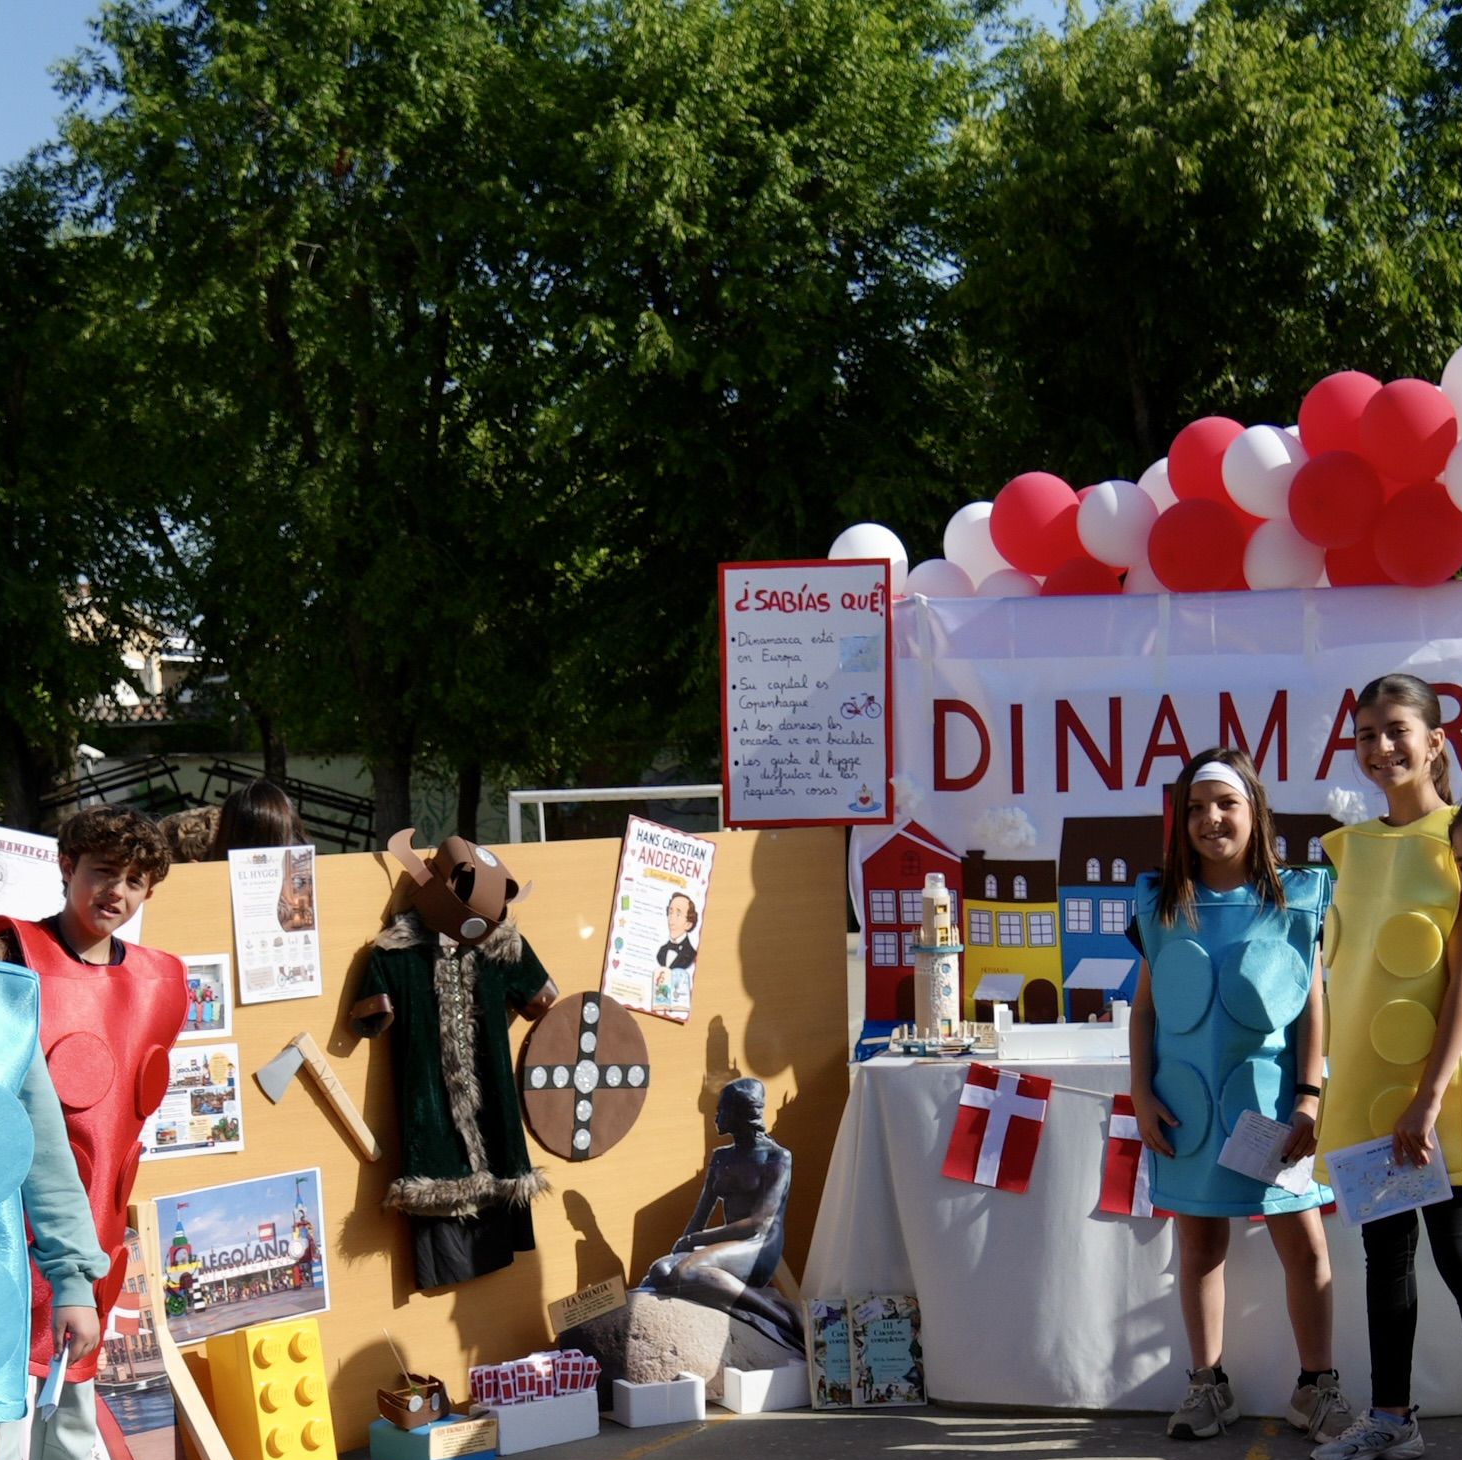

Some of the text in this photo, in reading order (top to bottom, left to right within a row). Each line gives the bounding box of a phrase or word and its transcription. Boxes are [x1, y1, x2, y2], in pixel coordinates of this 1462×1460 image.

[735, 581, 830, 613] ¿SABÍAS
[738, 628, 835, 647] Dinamarca está
[737, 649, 802, 668] en Europa
[739, 674, 829, 694] Su capital es
[740, 715, 843, 731] A los daneses les
[740, 730, 874, 746] encanta ir en bicicleta
[742, 750, 862, 773] Les gusta el hygge
[743, 767, 858, 788] y disfrutar de las
[743, 786, 796, 800] pequeñas
[636, 828, 707, 861] HANS CHRISTIAN
[638, 846, 702, 880] ANDERSEN
[201, 1239, 290, 1270] LEGOLAND
[882, 1322, 893, 1330] III
